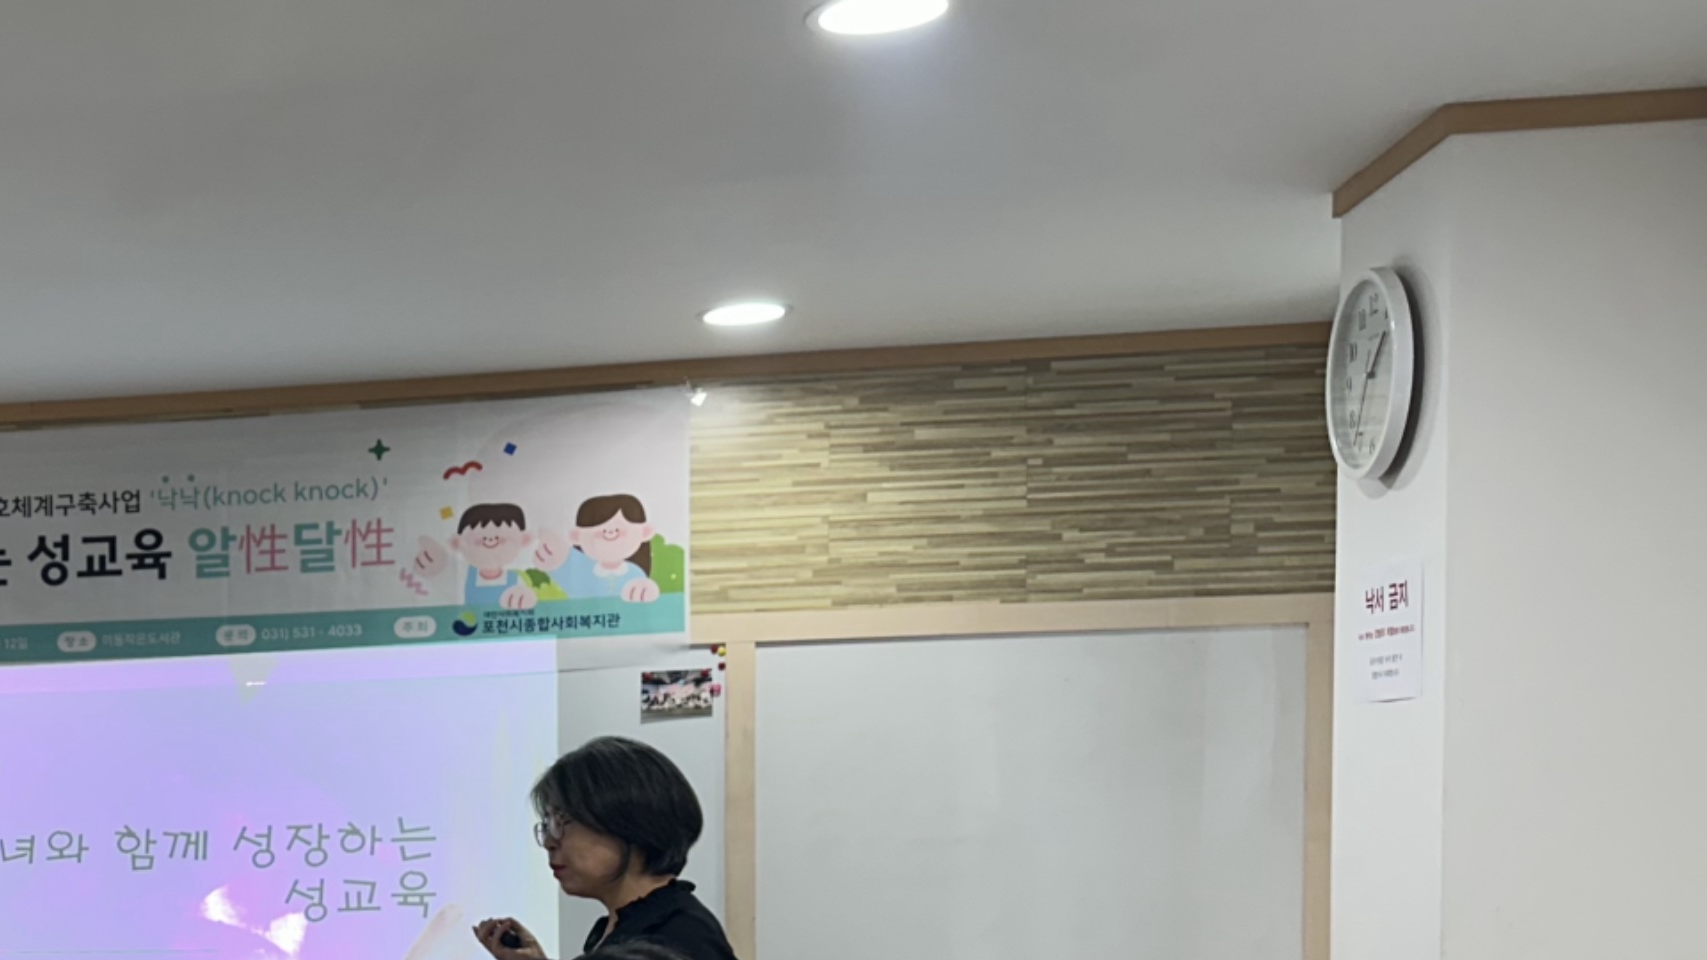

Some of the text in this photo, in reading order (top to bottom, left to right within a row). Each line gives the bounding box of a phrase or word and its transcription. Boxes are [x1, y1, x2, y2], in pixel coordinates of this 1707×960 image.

[26, 527, 173, 587] 성교육
[1365, 579, 1409, 615] 낙서 금지
[328, 623, 363, 637] 4033
[482, 613, 621, 635] 포천시종합사회복지관
[114, 824, 209, 871] 함께
[232, 816, 437, 869] 성장하는
[284, 870, 437, 923] 성교육
